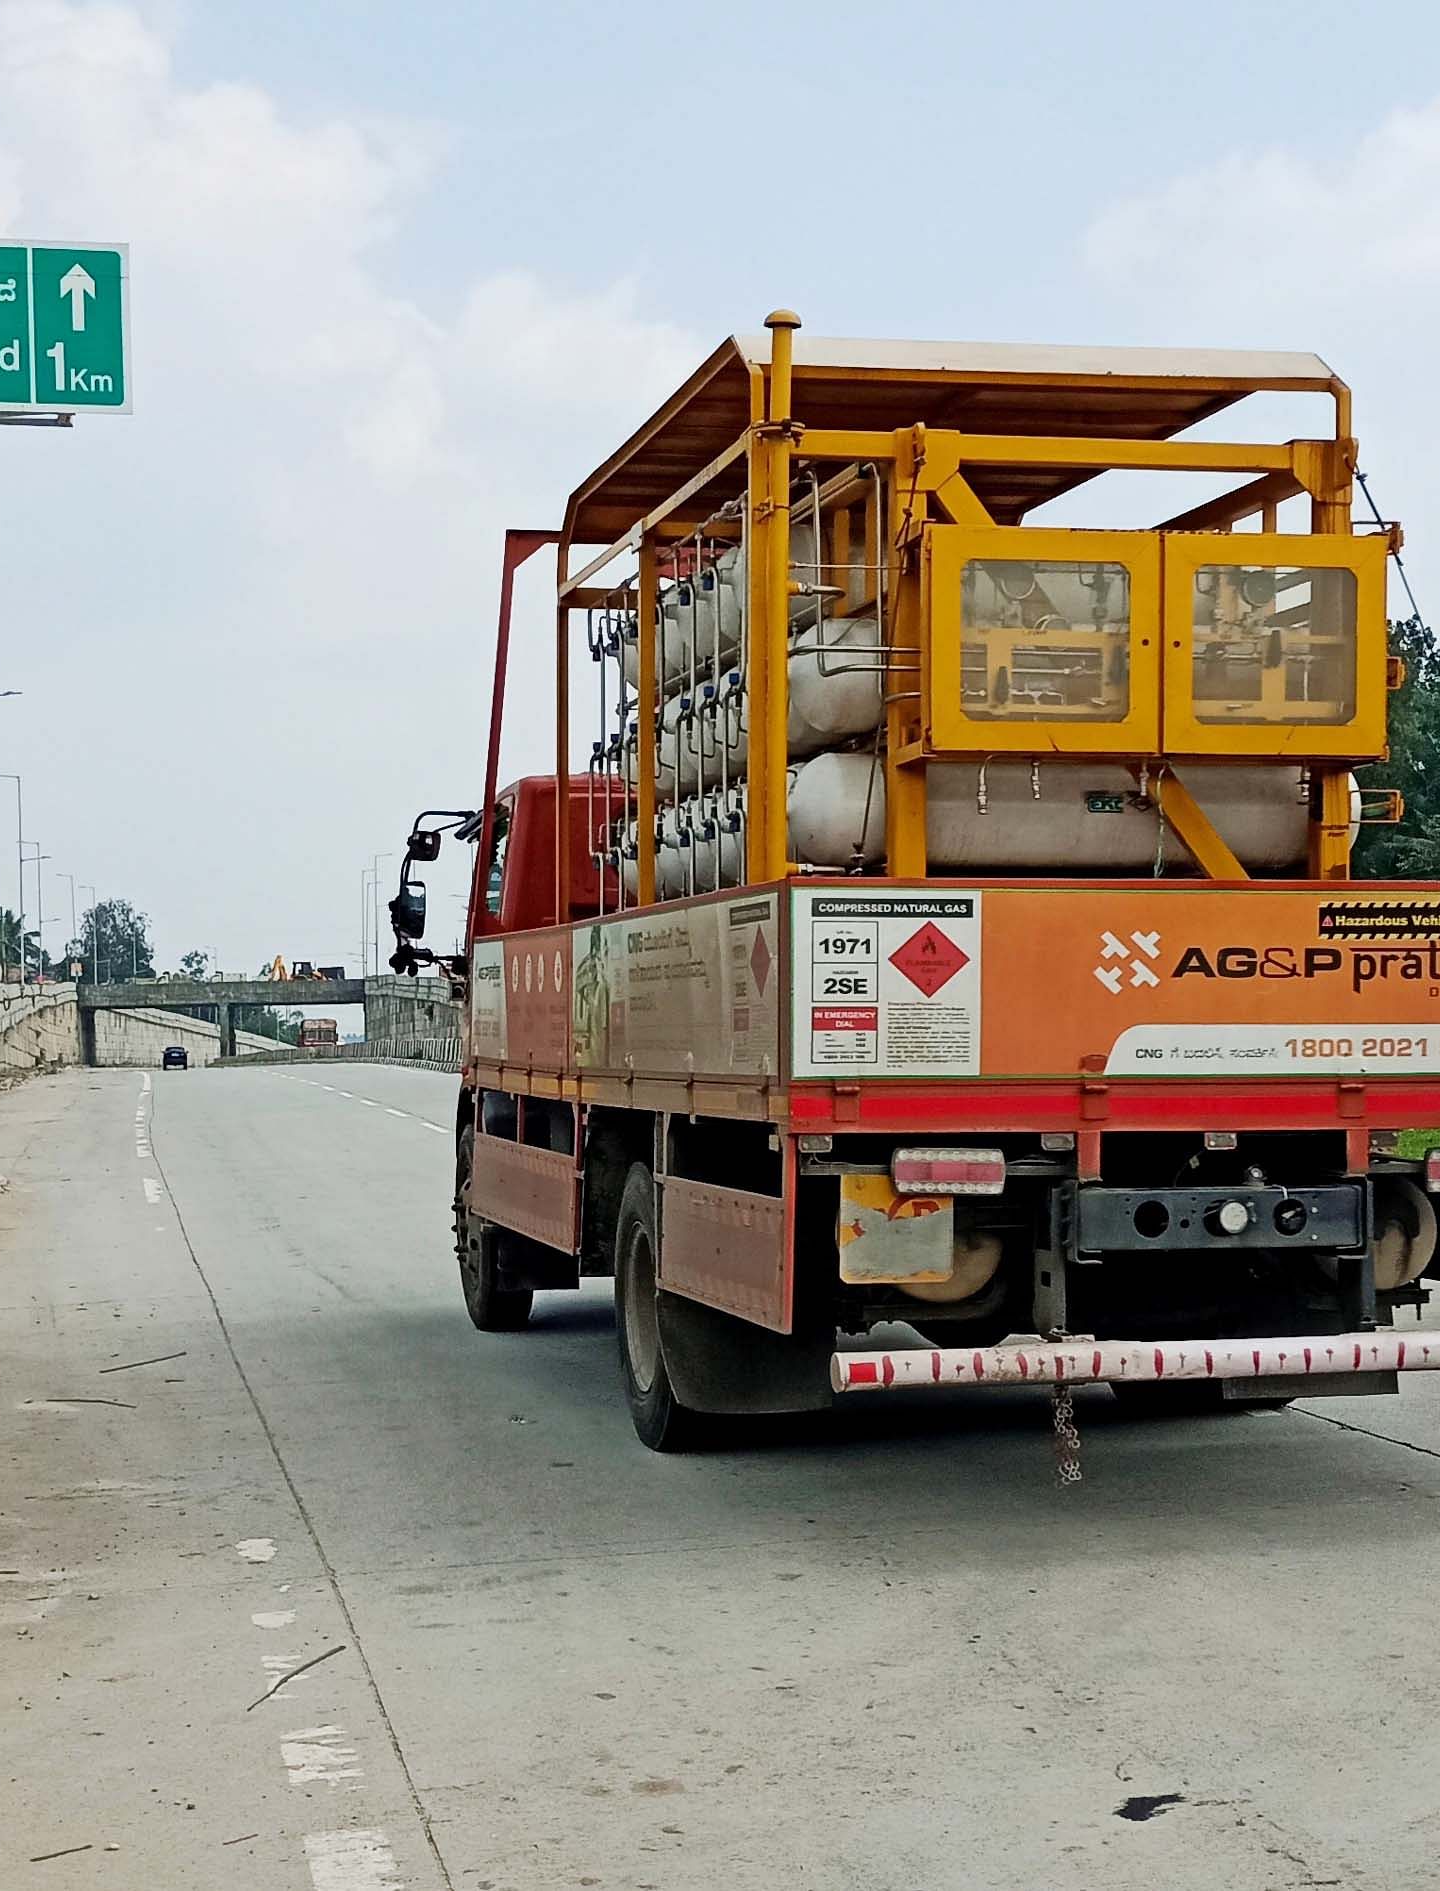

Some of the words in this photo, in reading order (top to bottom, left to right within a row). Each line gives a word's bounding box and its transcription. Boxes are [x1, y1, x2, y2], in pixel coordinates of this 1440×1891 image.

[46, 342, 65, 391] 1
[70, 369, 113, 392] Km
[818, 903, 892, 914] COMPRESSED
[893, 903, 943, 914] NATURAL
[944, 903, 968, 914] GAS
[1335, 914, 1408, 927] Hazardous
[818, 938, 871, 955] 1971
[1170, 947, 1342, 979] AG&P
[823, 978, 868, 995] 2SE
[814, 1011, 823, 1020] IN
[825, 1011, 876, 1020] EMERGENCY
[835, 1020, 855, 1028] DIAL
[1135, 1048, 1163, 1059] CNG
[1285, 1038, 1353, 1058] 1800
[1362, 1038, 1429, 1058] 2021
